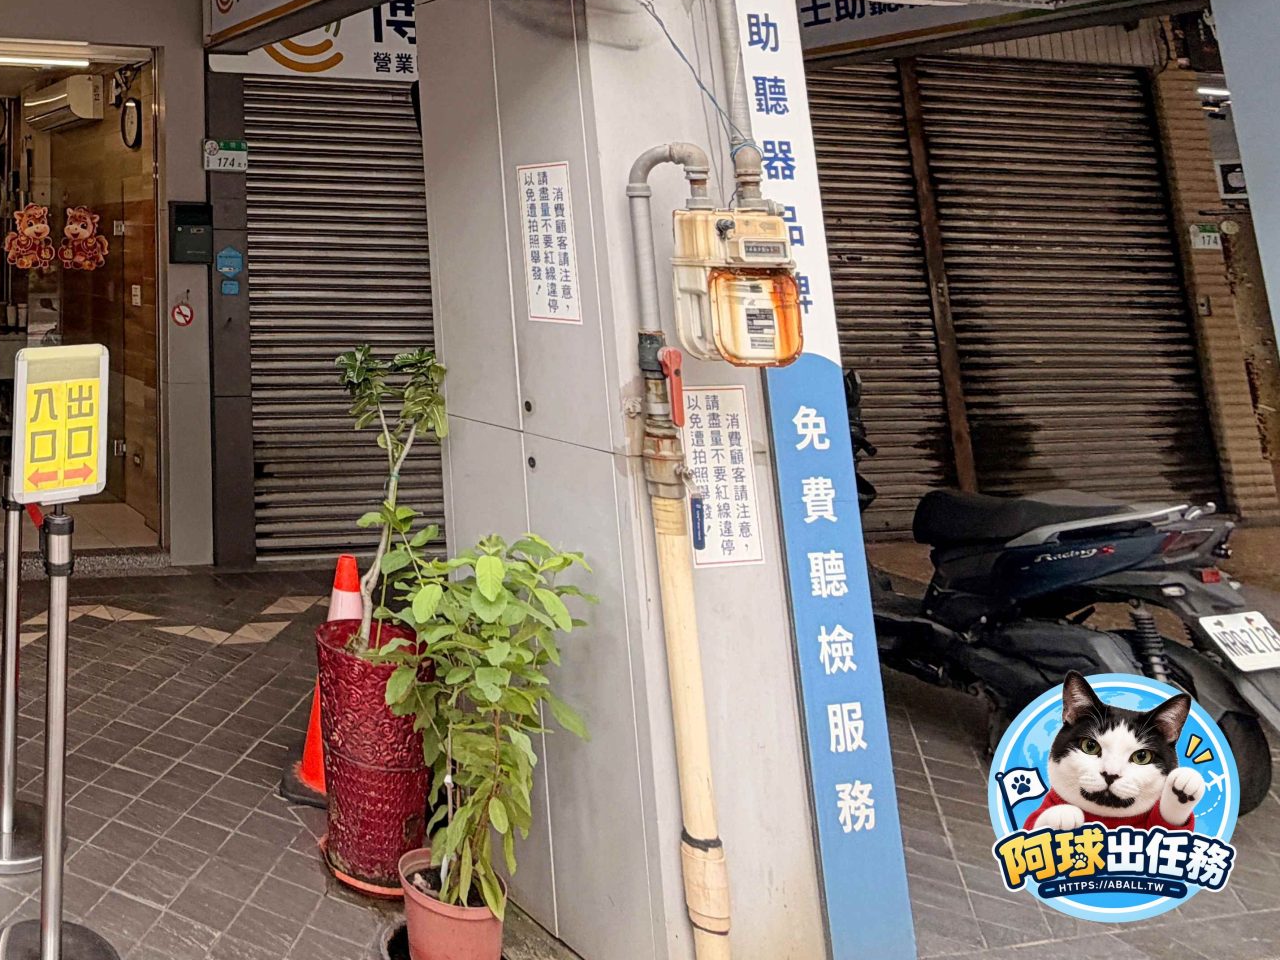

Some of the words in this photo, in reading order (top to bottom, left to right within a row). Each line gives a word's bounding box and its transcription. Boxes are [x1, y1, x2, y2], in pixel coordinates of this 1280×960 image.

[218, 157, 235, 168] 174
[29, 389, 58, 463] 入口
[67, 385, 93, 460] 出口
[705, 394, 735, 556] 請盡量不要紅線違停
[792, 405, 876, 834] 免費聽檢服務
